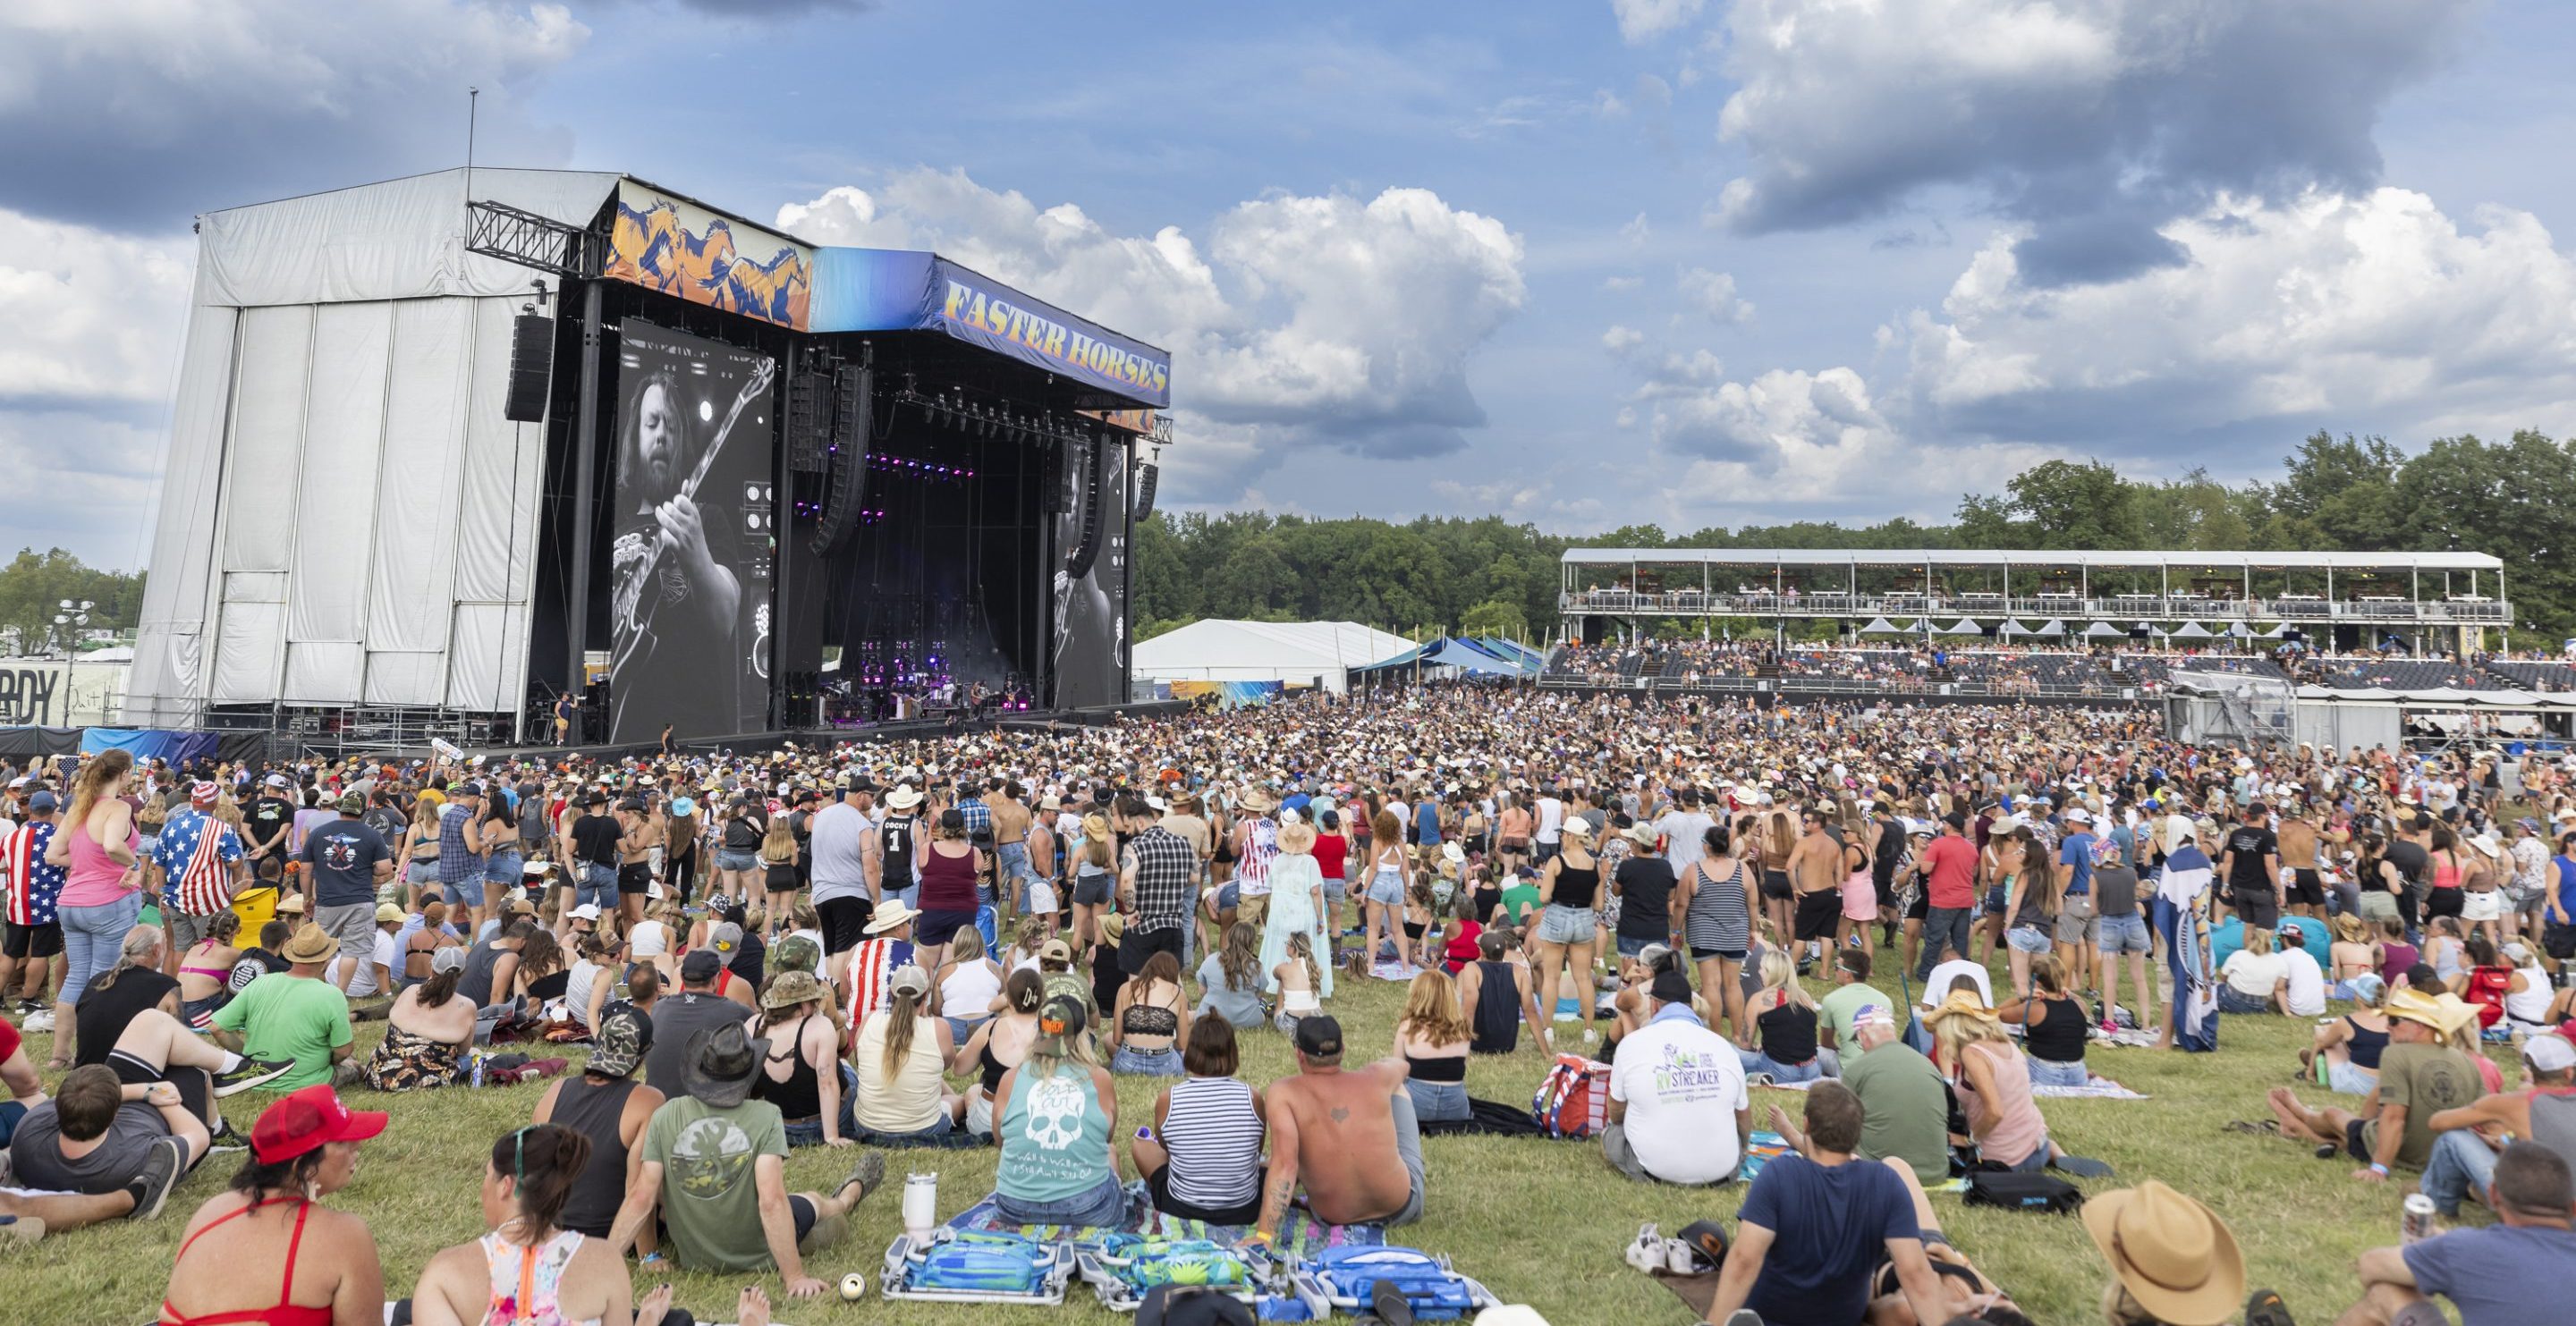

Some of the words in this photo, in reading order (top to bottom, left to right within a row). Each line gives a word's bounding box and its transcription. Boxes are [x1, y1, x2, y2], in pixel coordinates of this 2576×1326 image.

[943, 280, 1066, 358] FASTER
[1067, 330, 1167, 393] HORSES
[886, 822, 909, 830] COCKY
[889, 830, 900, 851] 1
[1041, 1095, 1073, 1111] OUT
[1016, 1152, 1037, 1161] Wall
[1050, 1155, 1071, 1168] Wall
